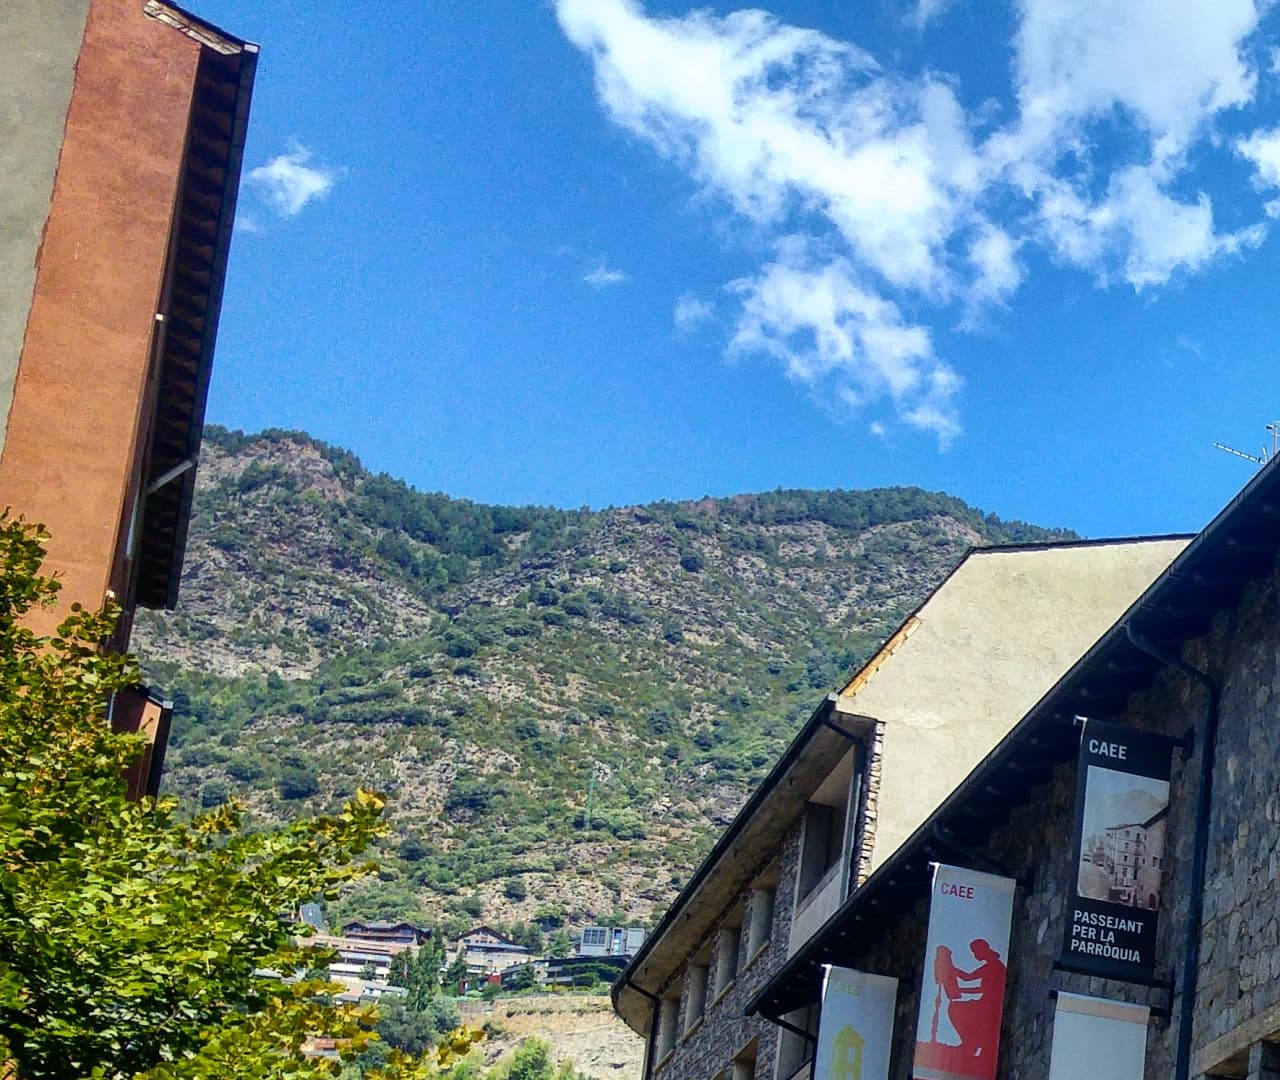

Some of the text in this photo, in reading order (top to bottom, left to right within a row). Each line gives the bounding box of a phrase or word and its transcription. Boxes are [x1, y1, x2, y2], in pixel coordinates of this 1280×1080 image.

[1089, 739, 1128, 760] CAEE
[940, 882, 975, 899] CAEE
[1073, 909, 1144, 934] PASSEJANT
[1072, 924, 1115, 943] PER LA
[1070, 938, 1141, 963] PARRÒQUIA
